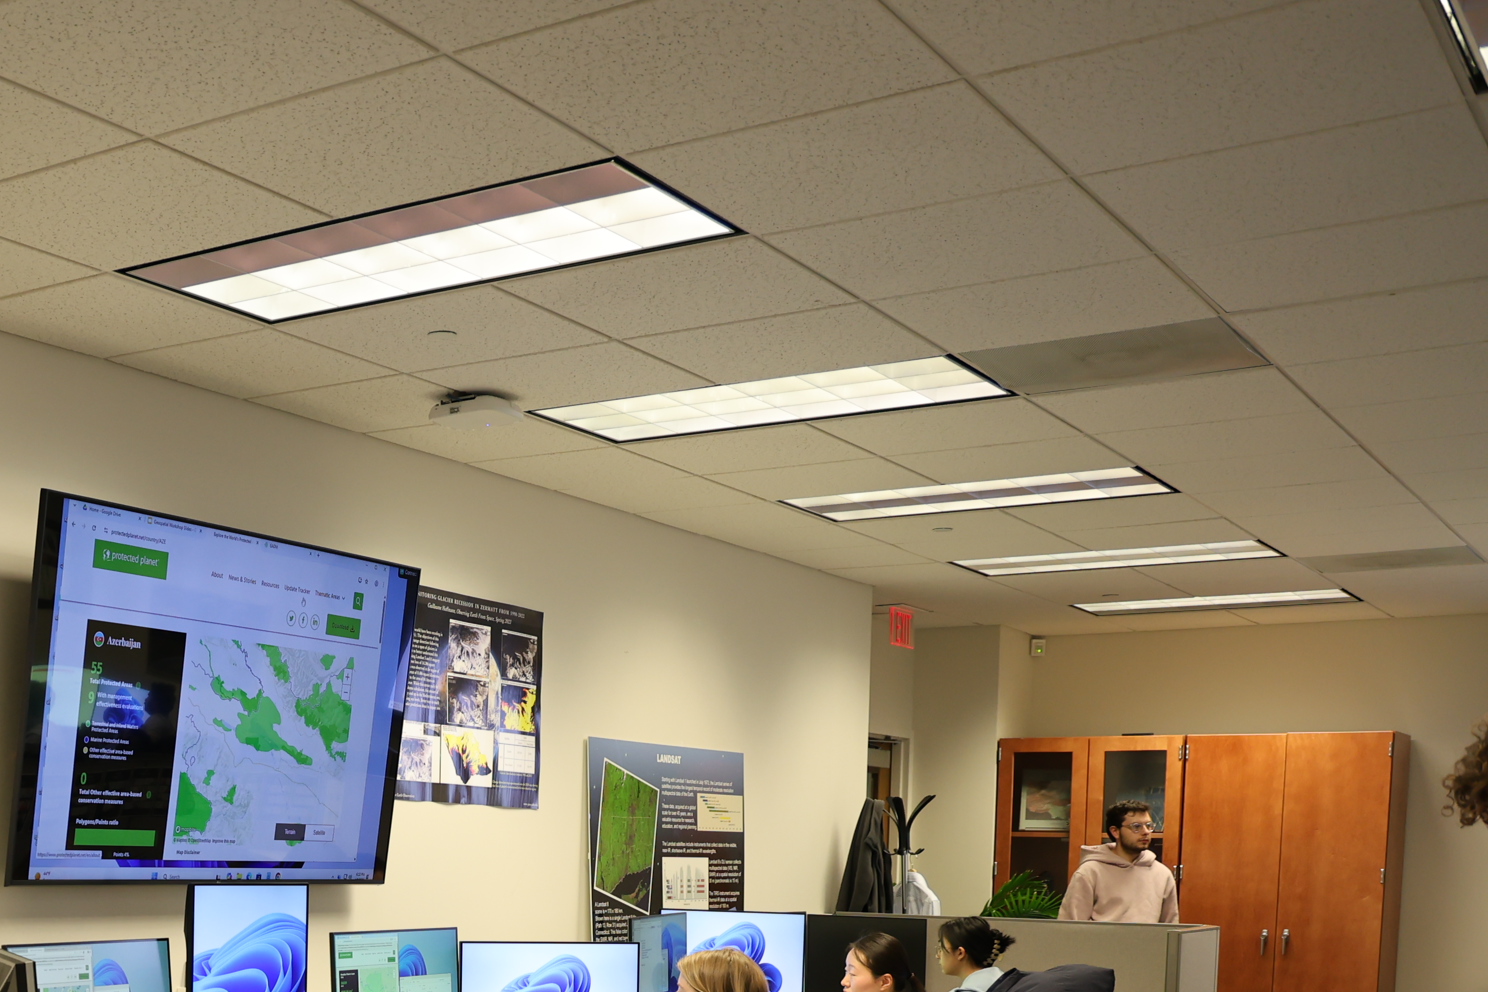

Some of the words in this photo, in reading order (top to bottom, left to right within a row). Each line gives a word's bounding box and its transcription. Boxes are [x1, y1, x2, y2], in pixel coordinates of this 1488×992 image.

[111, 552, 139, 563] protected
[210, 571, 224, 579] About
[228, 574, 239, 582] News
[243, 576, 256, 585] Stories
[261, 580, 280, 589] Resources
[284, 584, 297, 592] Update
[297, 586, 311, 594] Tracker
[315, 589, 330, 598] Thematic
[106, 636, 141, 649] Azerbaijan
[91, 661, 103, 675] 55
[89, 677, 100, 685] Total
[101, 679, 121, 687] Protected
[88, 691, 95, 704] 9
[657, 754, 681, 764] LANDSAT
[80, 772, 87, 785] 0
